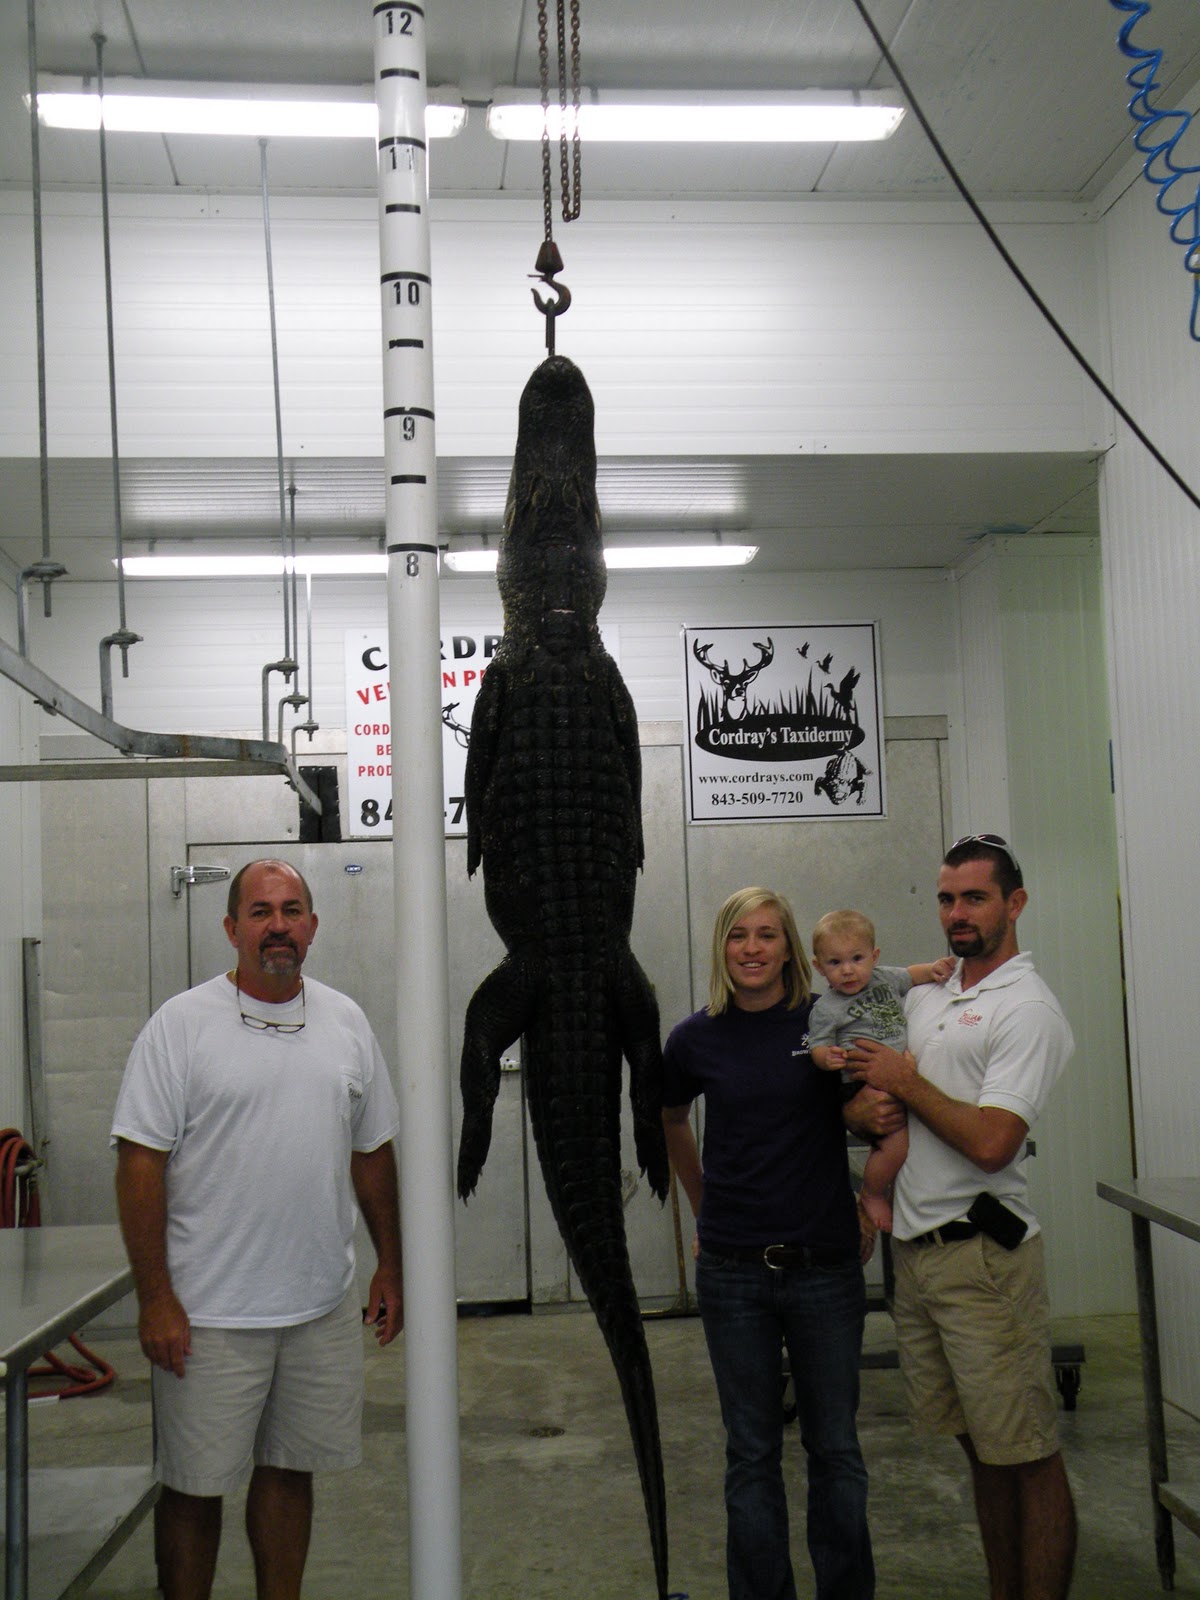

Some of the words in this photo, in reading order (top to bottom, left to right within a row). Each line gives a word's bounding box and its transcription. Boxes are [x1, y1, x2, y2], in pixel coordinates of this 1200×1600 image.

[385, 10, 412, 36] 12
[389, 146, 415, 170] 11
[393, 281, 420, 306] 10
[403, 416, 415, 441] 9
[406, 552, 420, 577] 8
[708, 727, 777, 749] Cordray's
[779, 726, 853, 746] Taxidermy
[699, 772, 814, 785] www.cordrays.com
[711, 791, 804, 806] 843-509-7720
